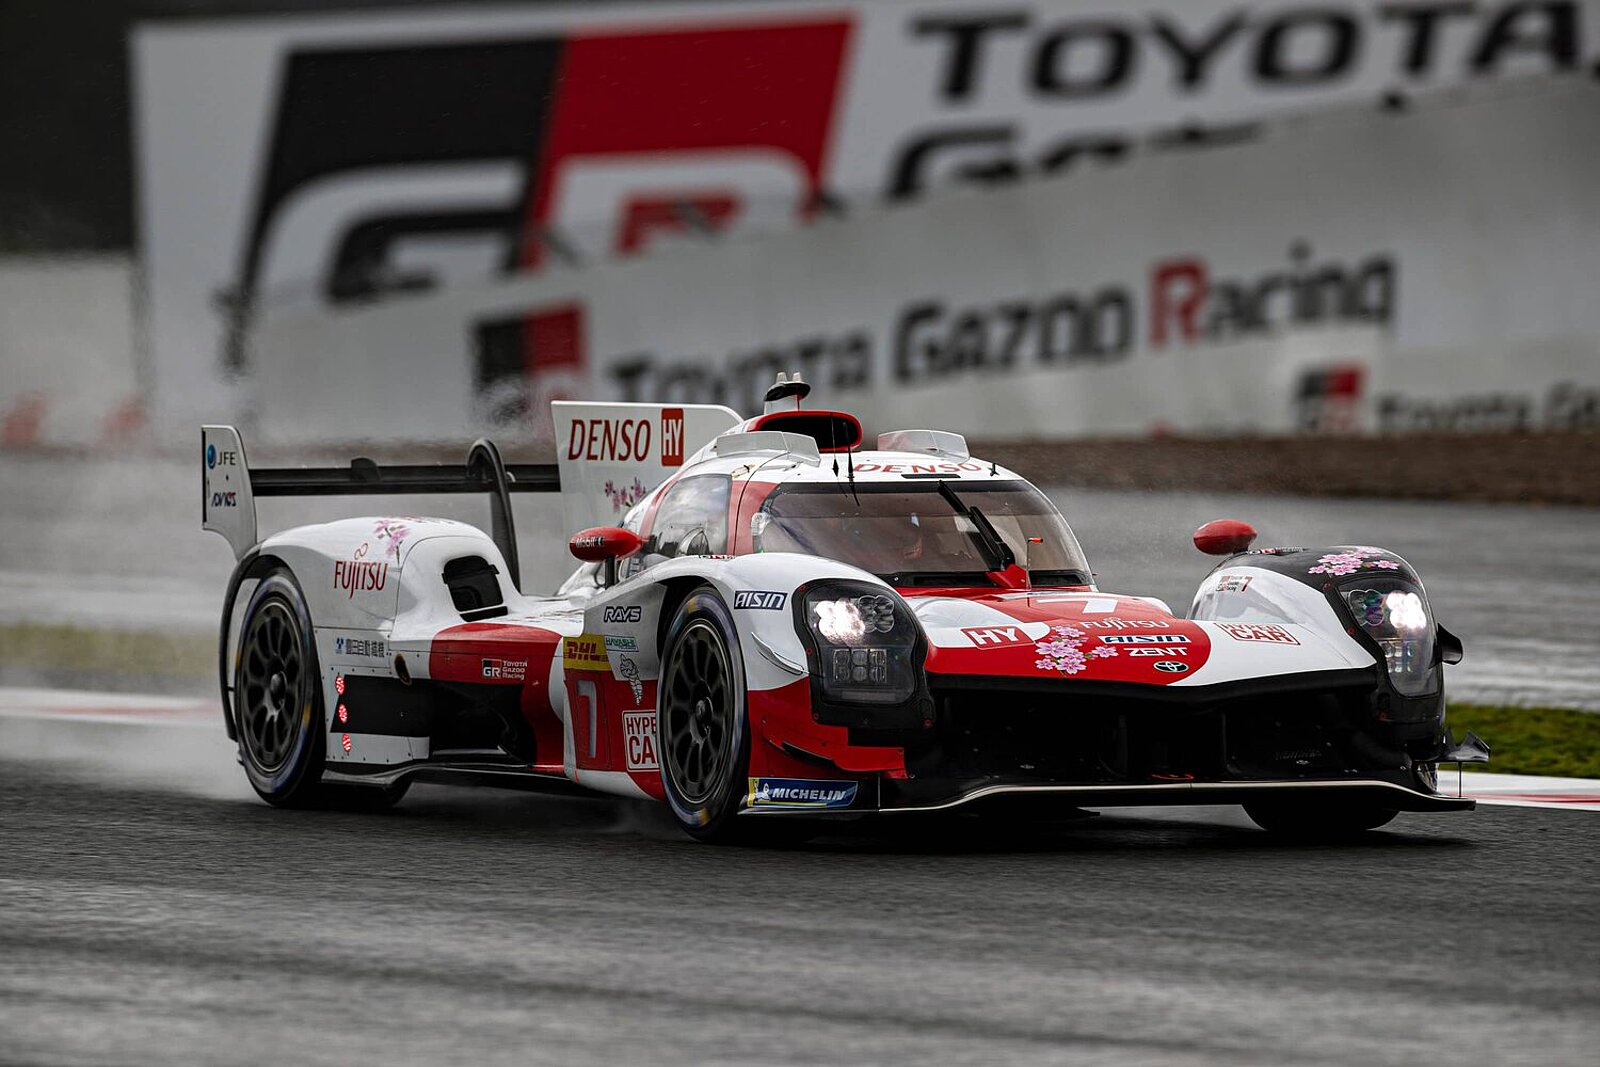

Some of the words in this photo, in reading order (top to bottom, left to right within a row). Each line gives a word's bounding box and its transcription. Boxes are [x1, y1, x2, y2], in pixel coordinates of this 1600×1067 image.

[910, 0, 1583, 102] TOYOTA
[1150, 238, 1396, 346] Racing
[568, 419, 651, 461] DENSO
[662, 418, 683, 456] HY
[217, 451, 236, 466] JFE
[853, 463, 981, 473] DENSO
[333, 559, 388, 600] FUJITSU
[1241, 575, 1253, 592] 7
[736, 591, 785, 609] AISIN
[604, 606, 641, 622] RAYS
[1082, 619, 1170, 630] FUJITSU
[970, 628, 1021, 645] HY
[1104, 635, 1187, 643] AISIN
[1231, 630, 1294, 642] CAR
[566, 641, 602, 662] DHL
[1124, 647, 1188, 657] ZENT
[483, 666, 501, 677] GR
[502, 672, 525, 680] Racing
[576, 680, 598, 758] 7
[626, 716, 658, 735] HYPE
[627, 735, 660, 765] CA
[772, 788, 847, 800] MICHELIN
